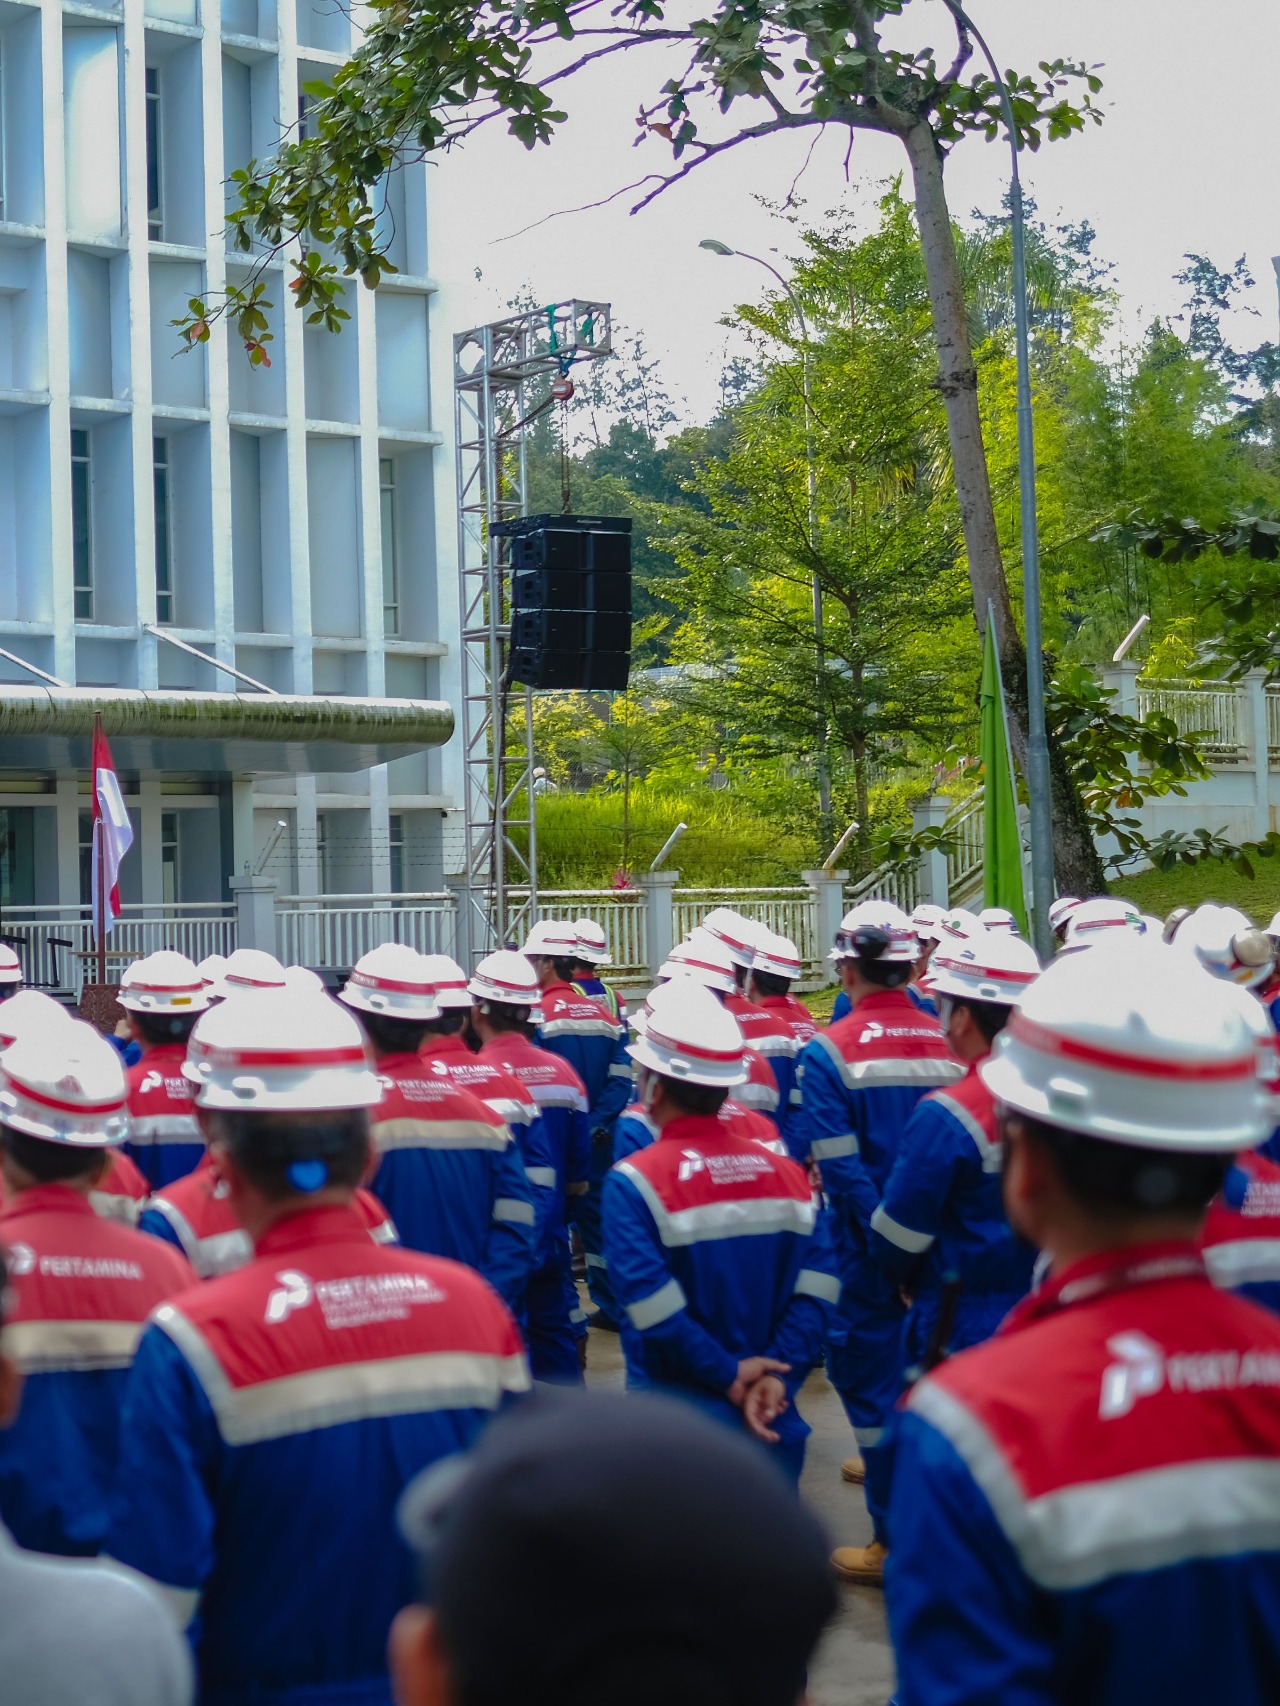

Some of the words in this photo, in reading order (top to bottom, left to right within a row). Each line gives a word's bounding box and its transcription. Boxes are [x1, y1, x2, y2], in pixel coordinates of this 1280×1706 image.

[449, 1064, 496, 1074] PERTAMINA
[40, 1255, 143, 1280] PERTAMINA
[315, 1273, 429, 1300] PERTAMINA
